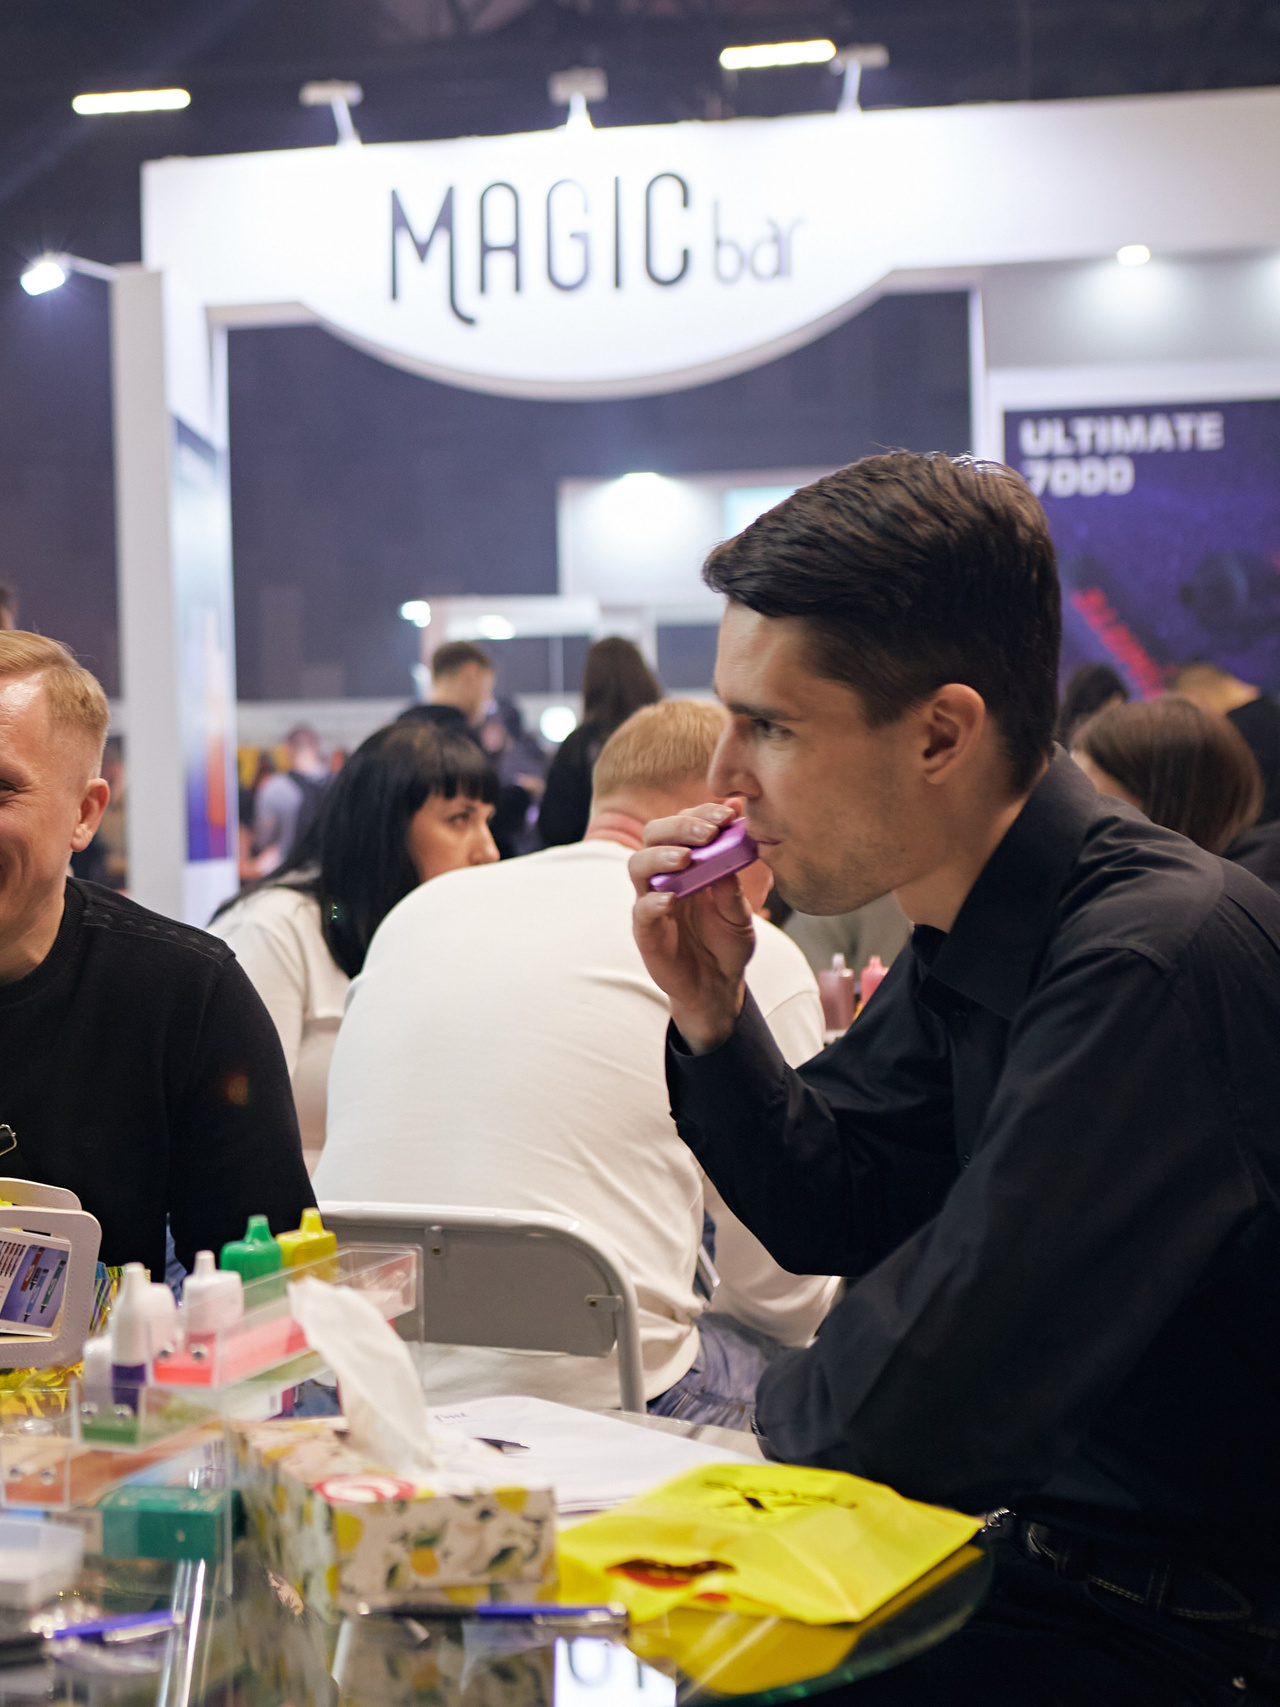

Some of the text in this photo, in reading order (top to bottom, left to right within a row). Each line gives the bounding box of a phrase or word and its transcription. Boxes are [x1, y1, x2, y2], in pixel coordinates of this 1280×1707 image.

[390, 172, 807, 326] MAGIC bar
[1019, 411, 1224, 457] ULTIMATE
[1022, 455, 1135, 498] 7000
